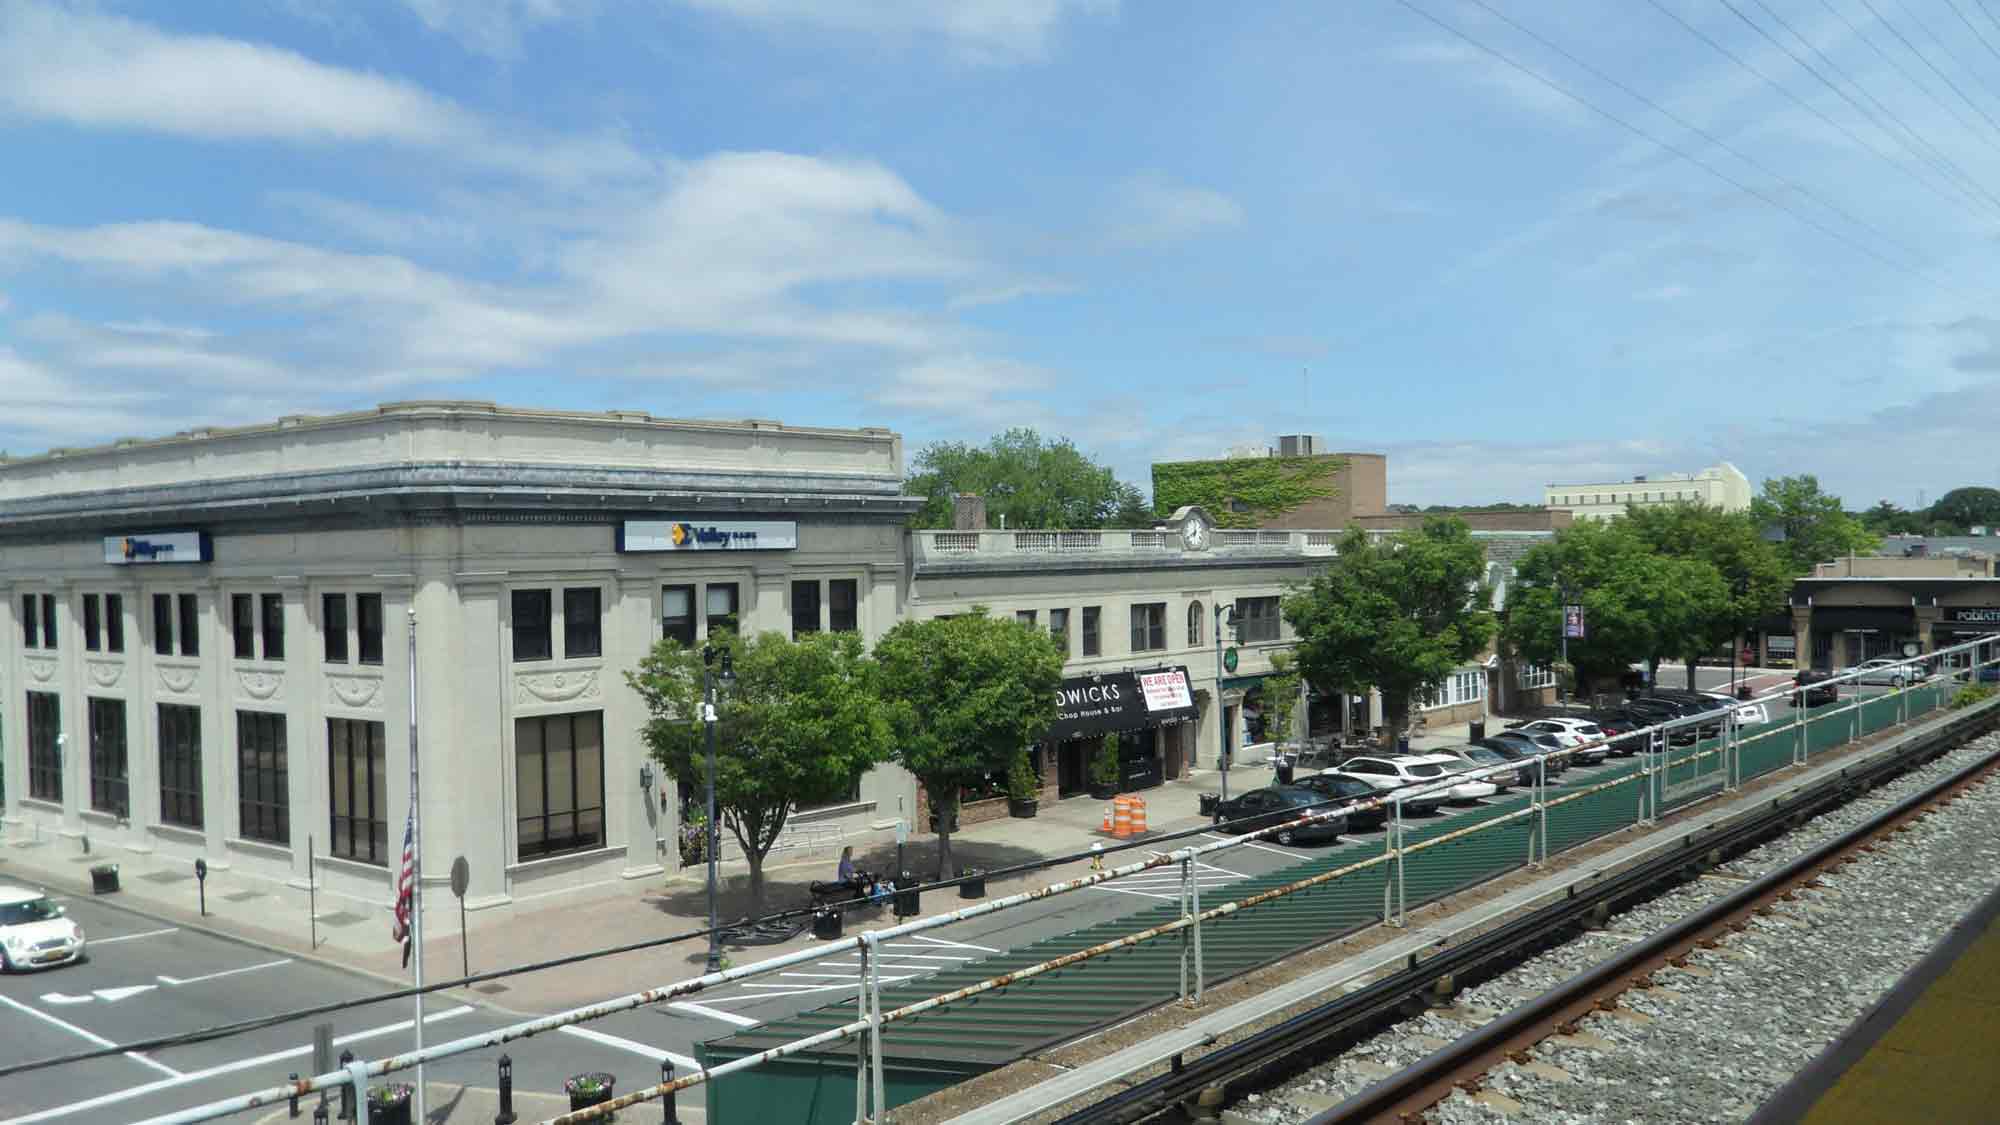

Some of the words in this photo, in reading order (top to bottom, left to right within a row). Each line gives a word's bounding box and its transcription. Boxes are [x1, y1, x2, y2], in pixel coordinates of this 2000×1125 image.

[1143, 676, 1154, 686] WE
[1154, 674, 1166, 685] ARE
[1167, 673, 1184, 684] OPEN
